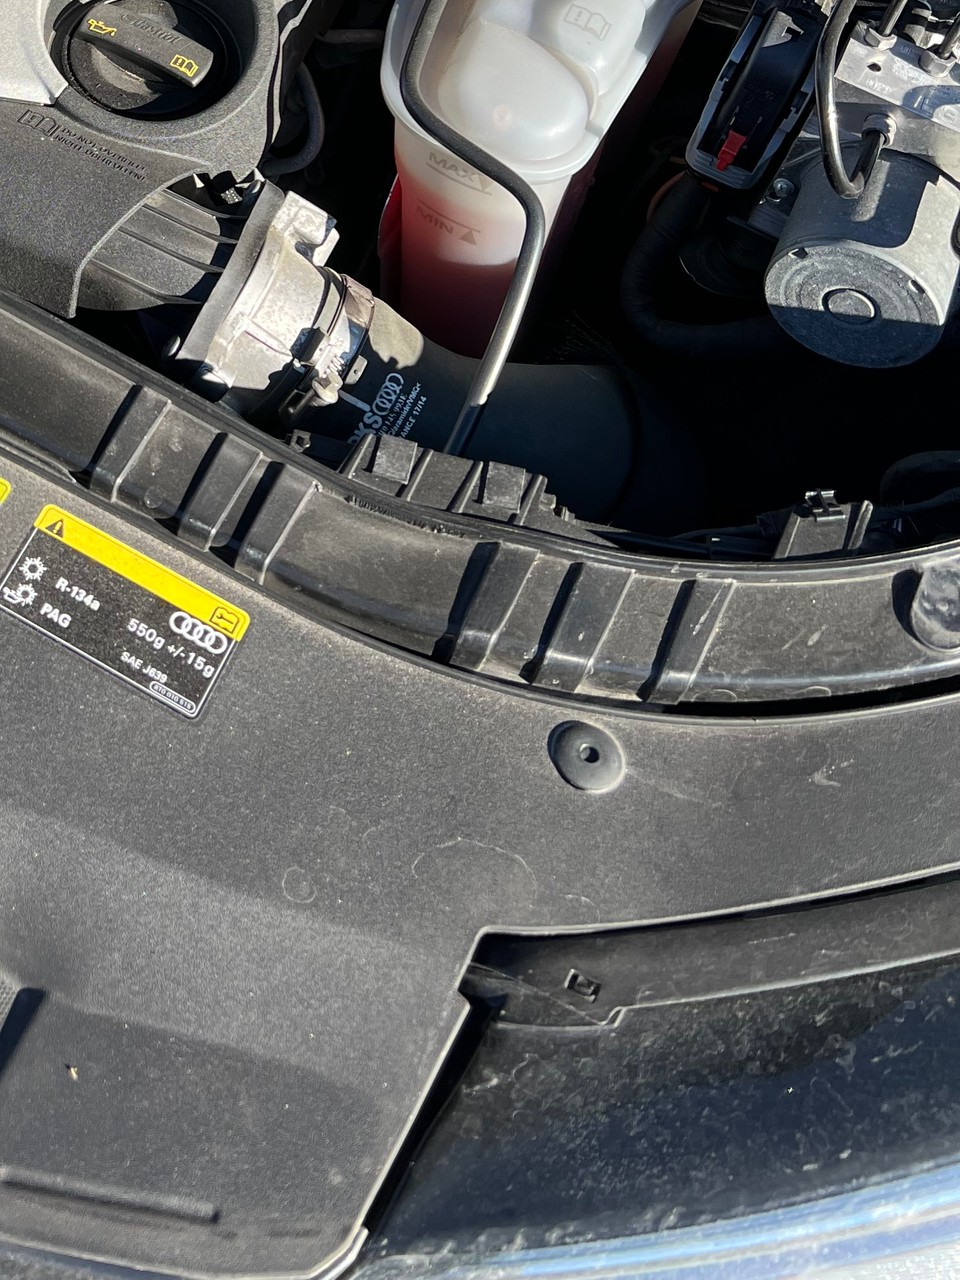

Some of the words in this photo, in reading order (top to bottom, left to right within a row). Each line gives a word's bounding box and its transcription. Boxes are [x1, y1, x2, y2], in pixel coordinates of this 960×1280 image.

[427, 150, 476, 184] MAX
[415, 204, 455, 235] MIN
[54, 577, 101, 612] R-134a
[40, 603, 72, 629] PAG
[127, 618, 166, 650] 550g
[120, 651, 143, 671] SAE
[143, 661, 169, 684] J639
